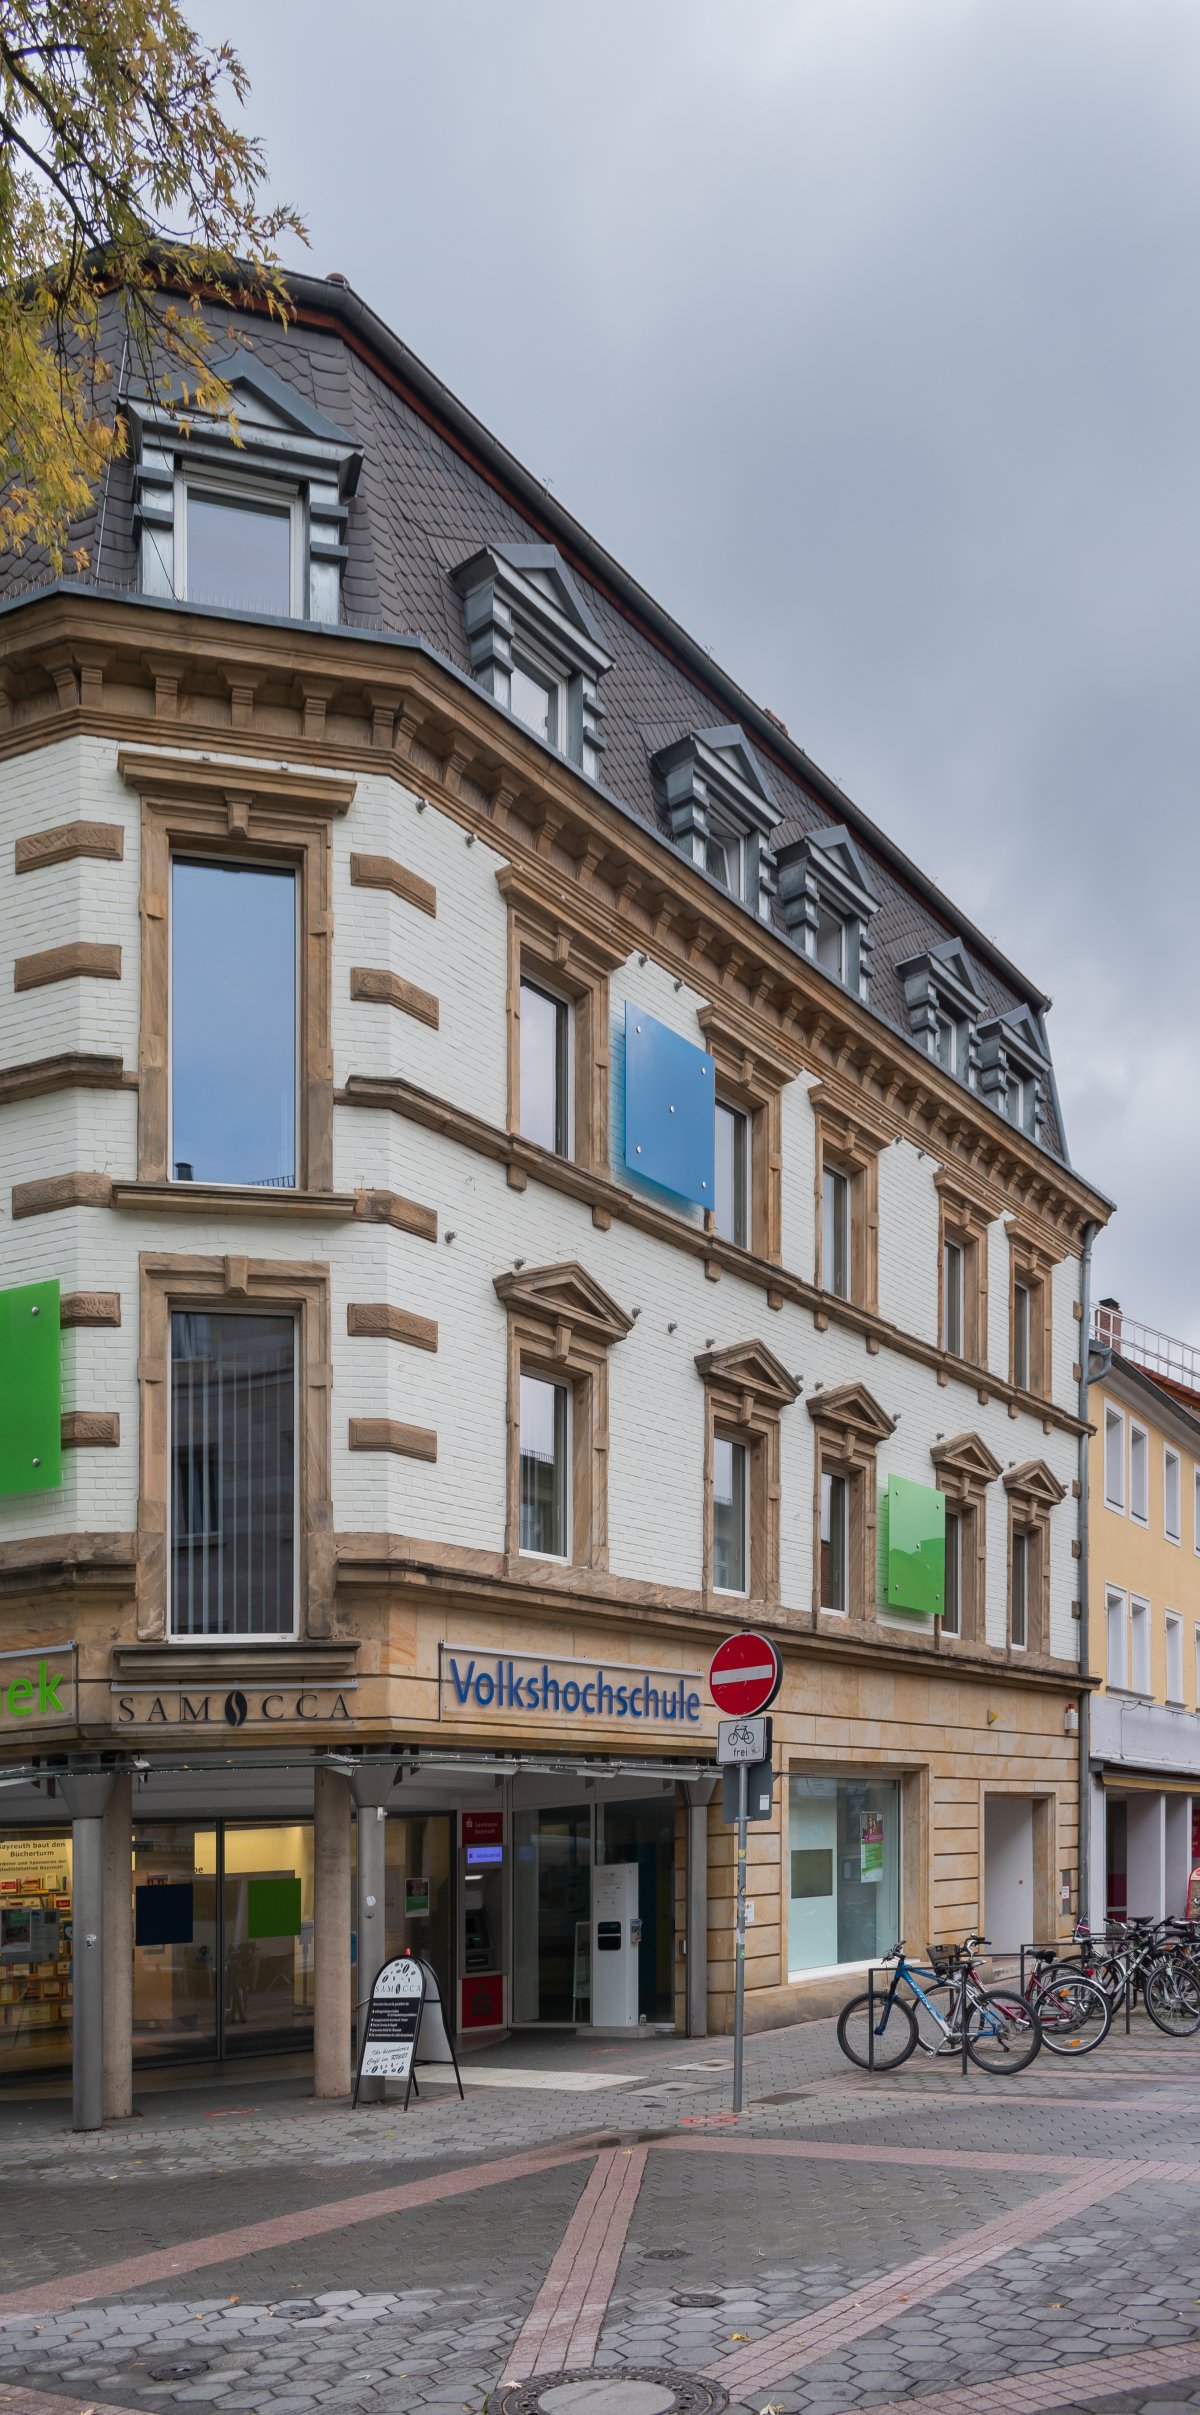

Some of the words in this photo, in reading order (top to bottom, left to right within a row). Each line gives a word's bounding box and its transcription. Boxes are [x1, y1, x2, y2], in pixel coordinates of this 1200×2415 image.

[0, 1659, 65, 1716] ek
[450, 1658, 700, 1721] Volkshochschule
[733, 1747, 748, 1758] frei
[0, 1842, 30, 1850] ayreuth
